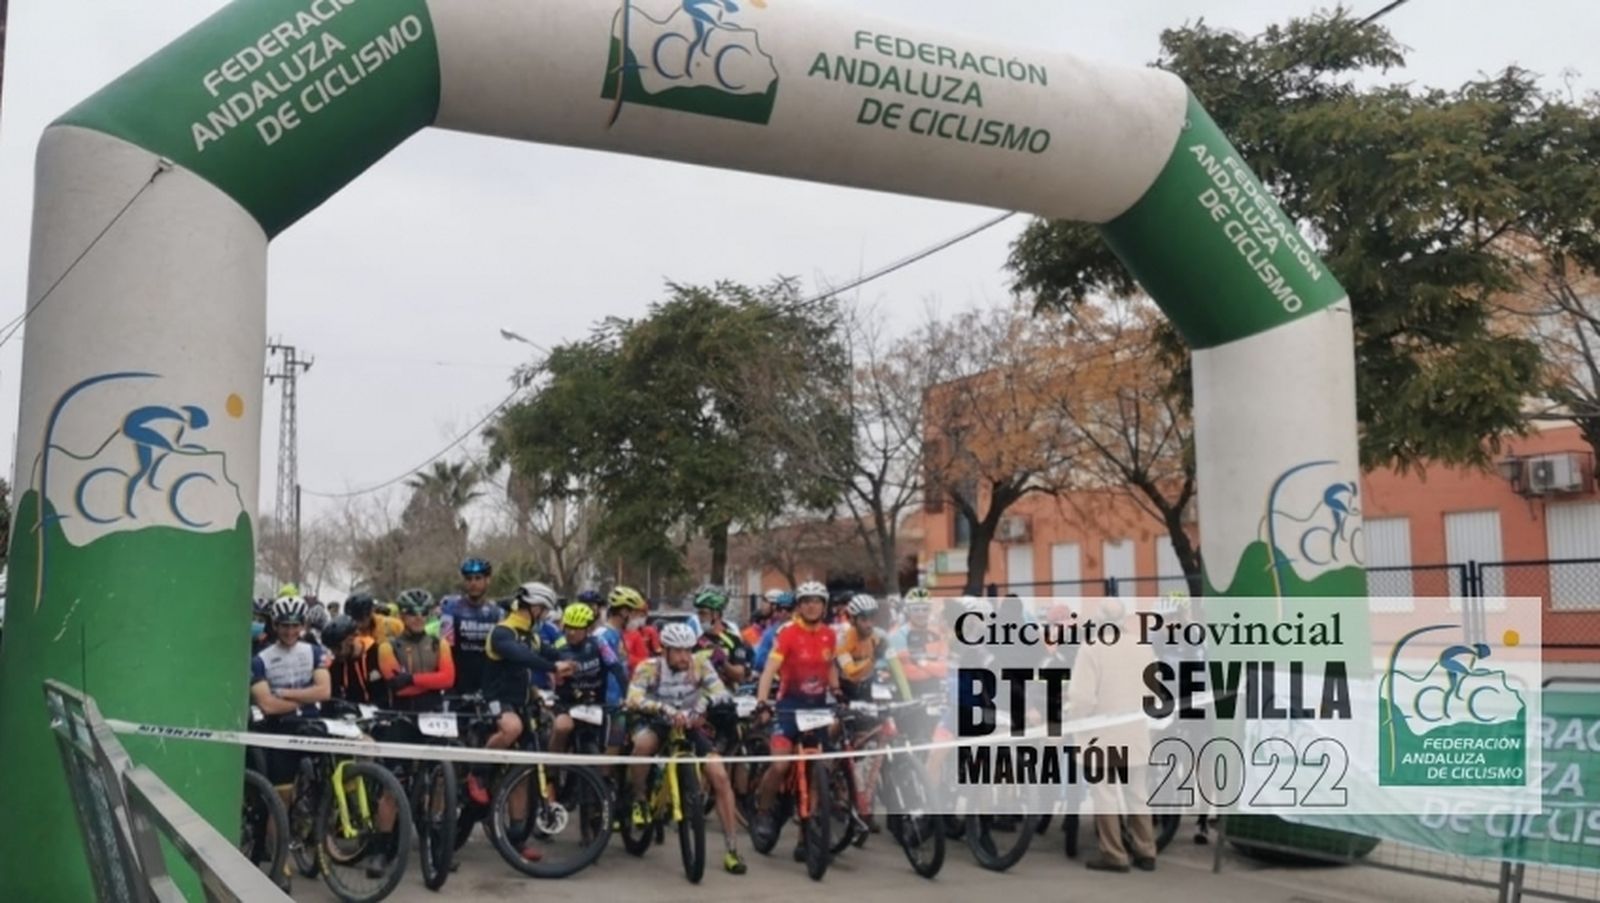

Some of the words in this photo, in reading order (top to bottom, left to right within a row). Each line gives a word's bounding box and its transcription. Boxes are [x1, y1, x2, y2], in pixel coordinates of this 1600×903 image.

[191, 32, 346, 152] ANDALUZA
[203, 0, 355, 97] FEDERACI
[256, 101, 301, 146] DE
[300, 14, 422, 113] CICLISMO
[808, 52, 983, 107] ANDALUZA
[855, 30, 1048, 87] FEDERACIÓN
[856, 98, 904, 130] DE
[909, 107, 1051, 154] CICLISMO
[1189, 144, 1279, 254] ANDALUZA
[1198, 188, 1231, 223] DE
[1223, 220, 1302, 313] CICLISMO
[1418, 797, 1476, 835] DE
